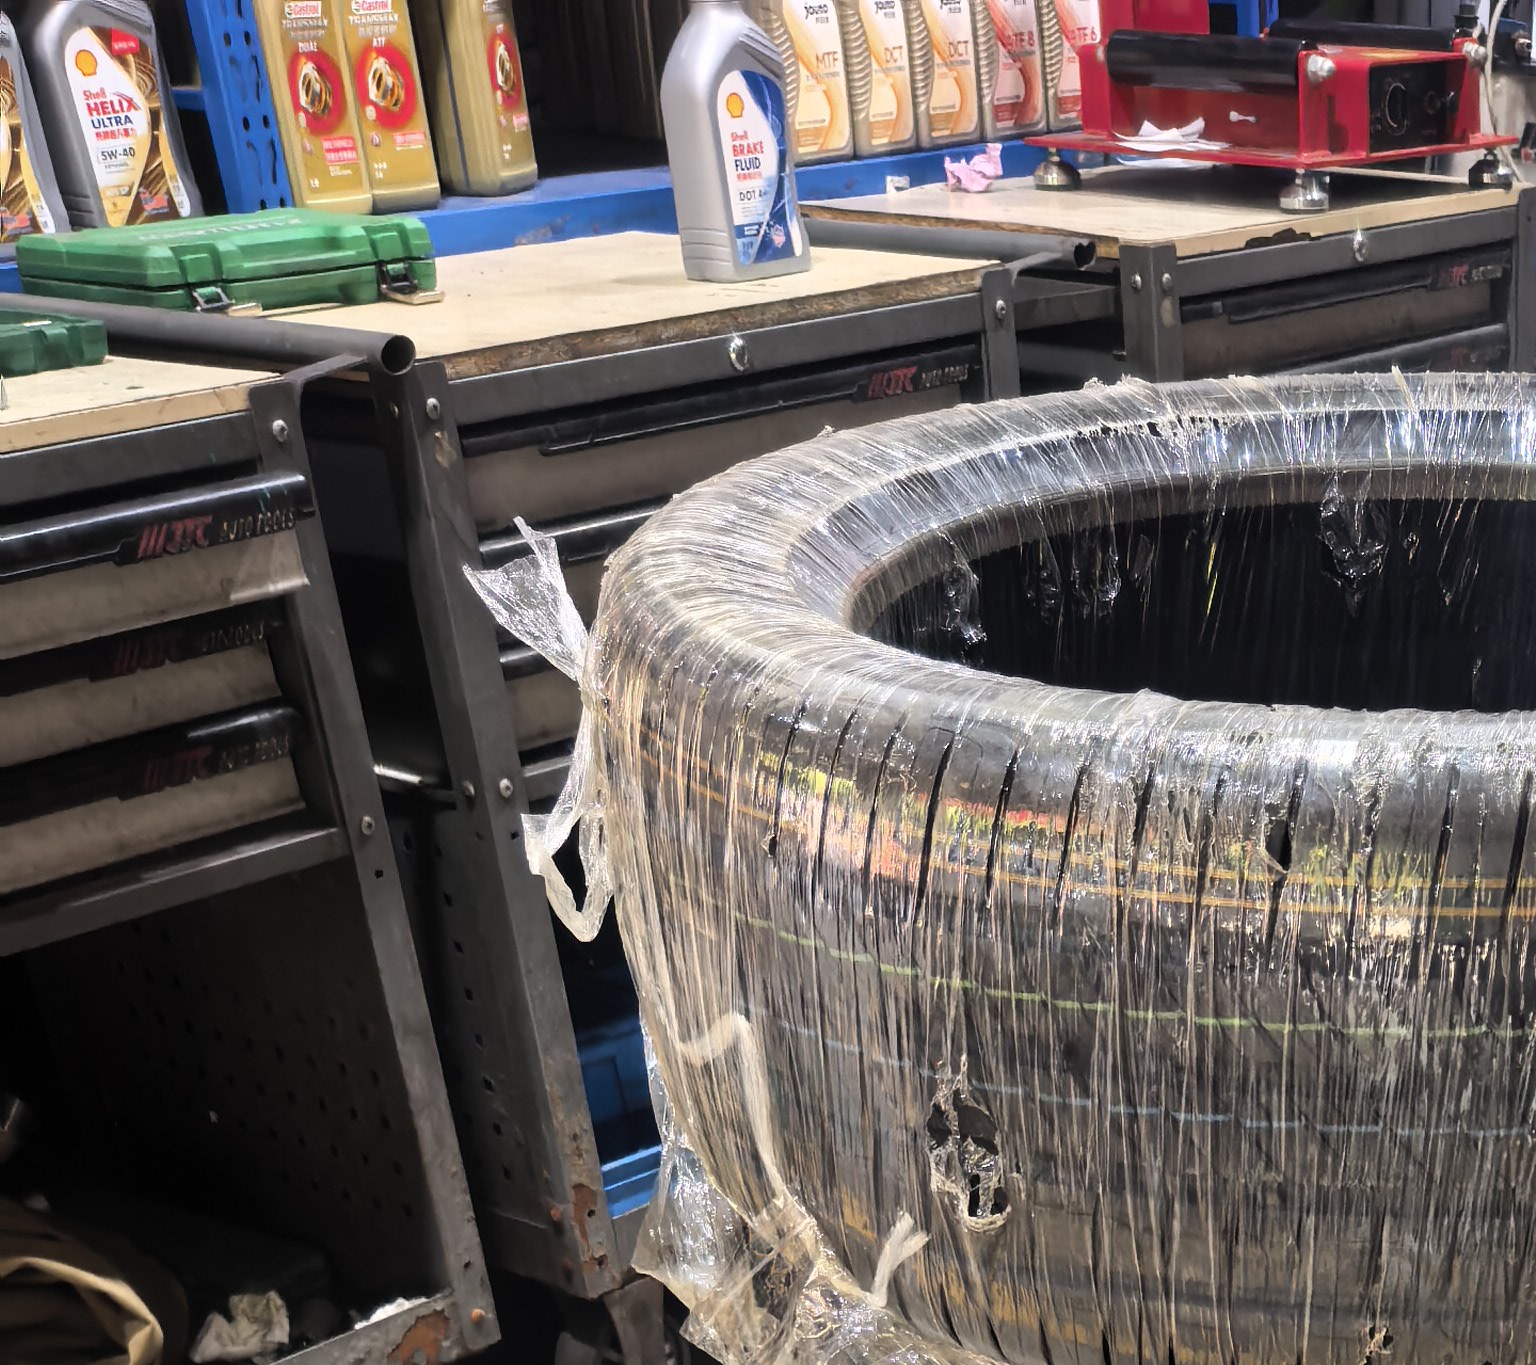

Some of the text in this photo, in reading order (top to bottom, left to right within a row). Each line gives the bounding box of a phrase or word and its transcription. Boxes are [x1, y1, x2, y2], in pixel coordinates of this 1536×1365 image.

[884, 46, 903, 63] DCT
[948, 40, 969, 58] DCT
[815, 51, 838, 69] MTF
[83, 87, 107, 101] Shell
[86, 95, 140, 116] HELIX
[91, 115, 133, 129] ULTRA
[101, 147, 136, 160] 5W-40
[732, 141, 764, 157] BRAKE
[735, 157, 761, 172] FLUID
[740, 190, 756, 200] DOT
